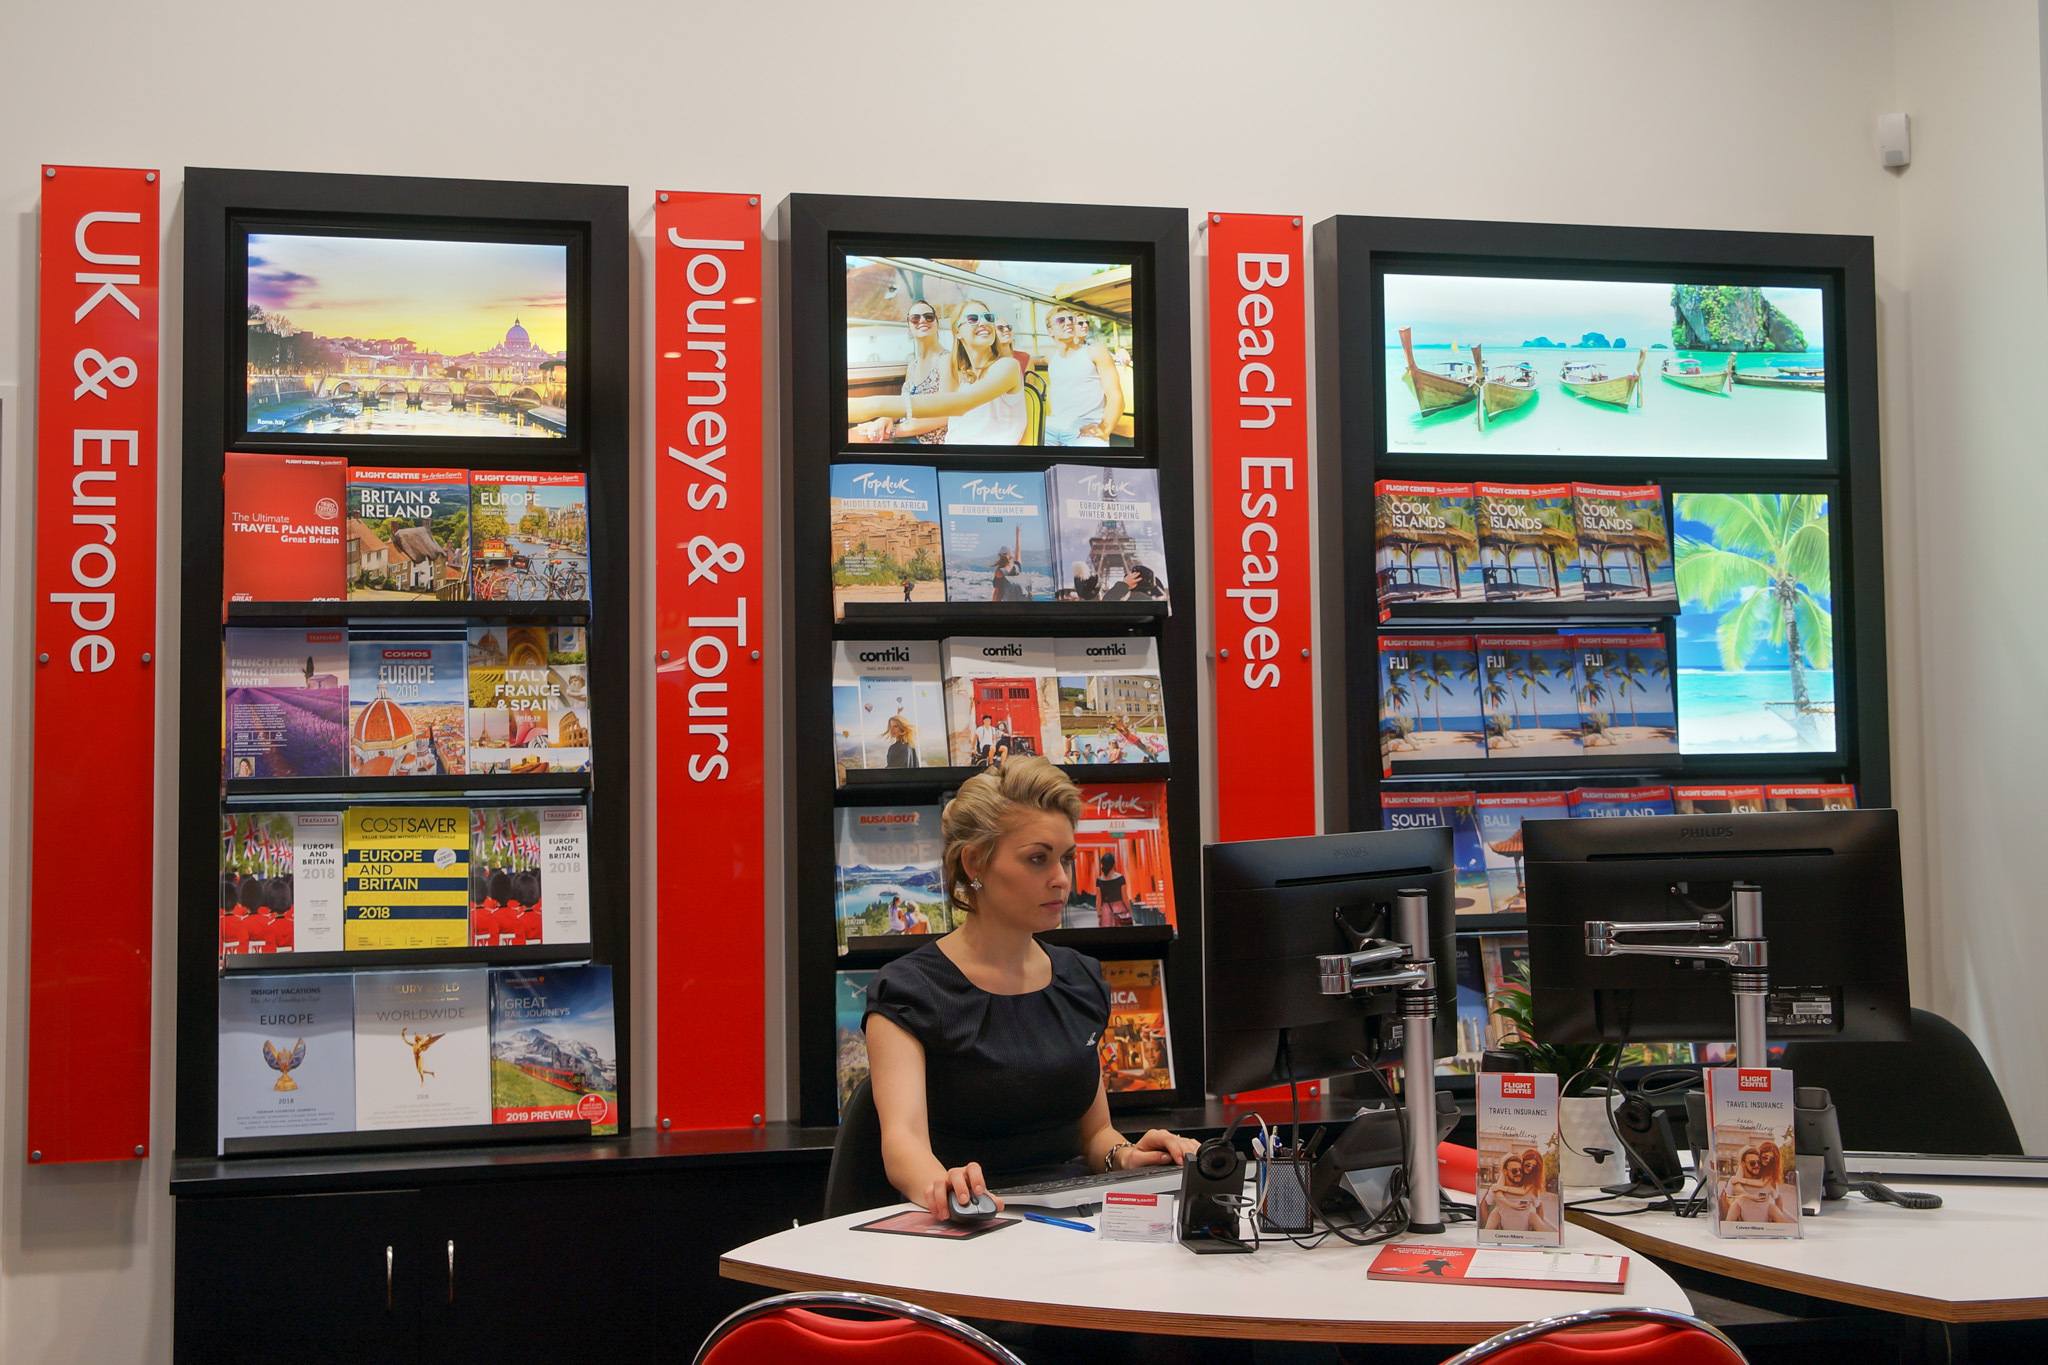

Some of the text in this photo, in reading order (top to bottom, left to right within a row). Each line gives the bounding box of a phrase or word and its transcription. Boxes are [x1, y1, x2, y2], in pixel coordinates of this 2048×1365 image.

[50, 211, 140, 673] UK & Europe
[1226, 252, 1293, 689] Beach Escapes
[852, 472, 915, 496] Topdeck
[1078, 475, 1136, 498] Topdeck
[362, 490, 440, 504] BRITAIN &
[962, 479, 1024, 503] Topdeck
[1576, 487, 1596, 495] FLIGHT
[481, 493, 541, 506] EUROPE
[668, 227, 746, 782] Journeys & Tours
[361, 504, 432, 519] IRELAND
[1080, 502, 1138, 512] EUROPE AUTUMN,
[1392, 502, 1431, 515] COOK
[1489, 504, 1527, 516] COOK
[1582, 504, 1618, 517] COOK
[232, 512, 289, 523] The Ultimate
[1392, 515, 1445, 528] ISLANDS
[1491, 516, 1542, 530] ISLANDS
[1583, 517, 1633, 530] ISLANDS
[232, 523, 339, 535] TRAVEL PLANNER
[860, 647, 909, 662] contiki
[982, 644, 1022, 656] contiki
[1086, 644, 1126, 656] contiki
[232, 659, 298, 667] FRENCH FLAIR
[1390, 657, 1408, 669] FIJI
[1487, 656, 1505, 668] FIJI
[1585, 654, 1603, 666] FIJI
[380, 666, 434, 684] EUROPE
[505, 670, 550, 682] ITALY
[396, 685, 418, 698] 2018
[495, 685, 560, 696] FRANCE
[497, 700, 558, 711] & SPAIN
[1088, 792, 1145, 817] Topdeck
[1589, 808, 1655, 817] THAILAND
[860, 814, 916, 824] BUSABOUT
[1392, 814, 1436, 827] SOUTH
[1484, 815, 1510, 827] BALI
[361, 818, 456, 833] COSTSAVER
[1681, 827, 1734, 838] PHILIPS
[359, 851, 422, 862] EUROPE
[850, 843, 932, 864] EUROPE
[303, 868, 335, 879] 2018
[359, 864, 393, 875] AND
[550, 863, 581, 873] 2018
[359, 878, 418, 890] BRITAIN
[359, 907, 390, 918] 2018
[504, 997, 547, 1009] GREAT
[260, 1013, 314, 1025] EUROPE
[376, 1007, 465, 1022] WORLDWIDE
[504, 1008, 570, 1018] RAIL JOURNEYS
[506, 1113, 528, 1121] 2019
[531, 1110, 573, 1120] PREVIEW
[1740, 1123, 1774, 1136] travelling
[1502, 1130, 1537, 1143] travelling
